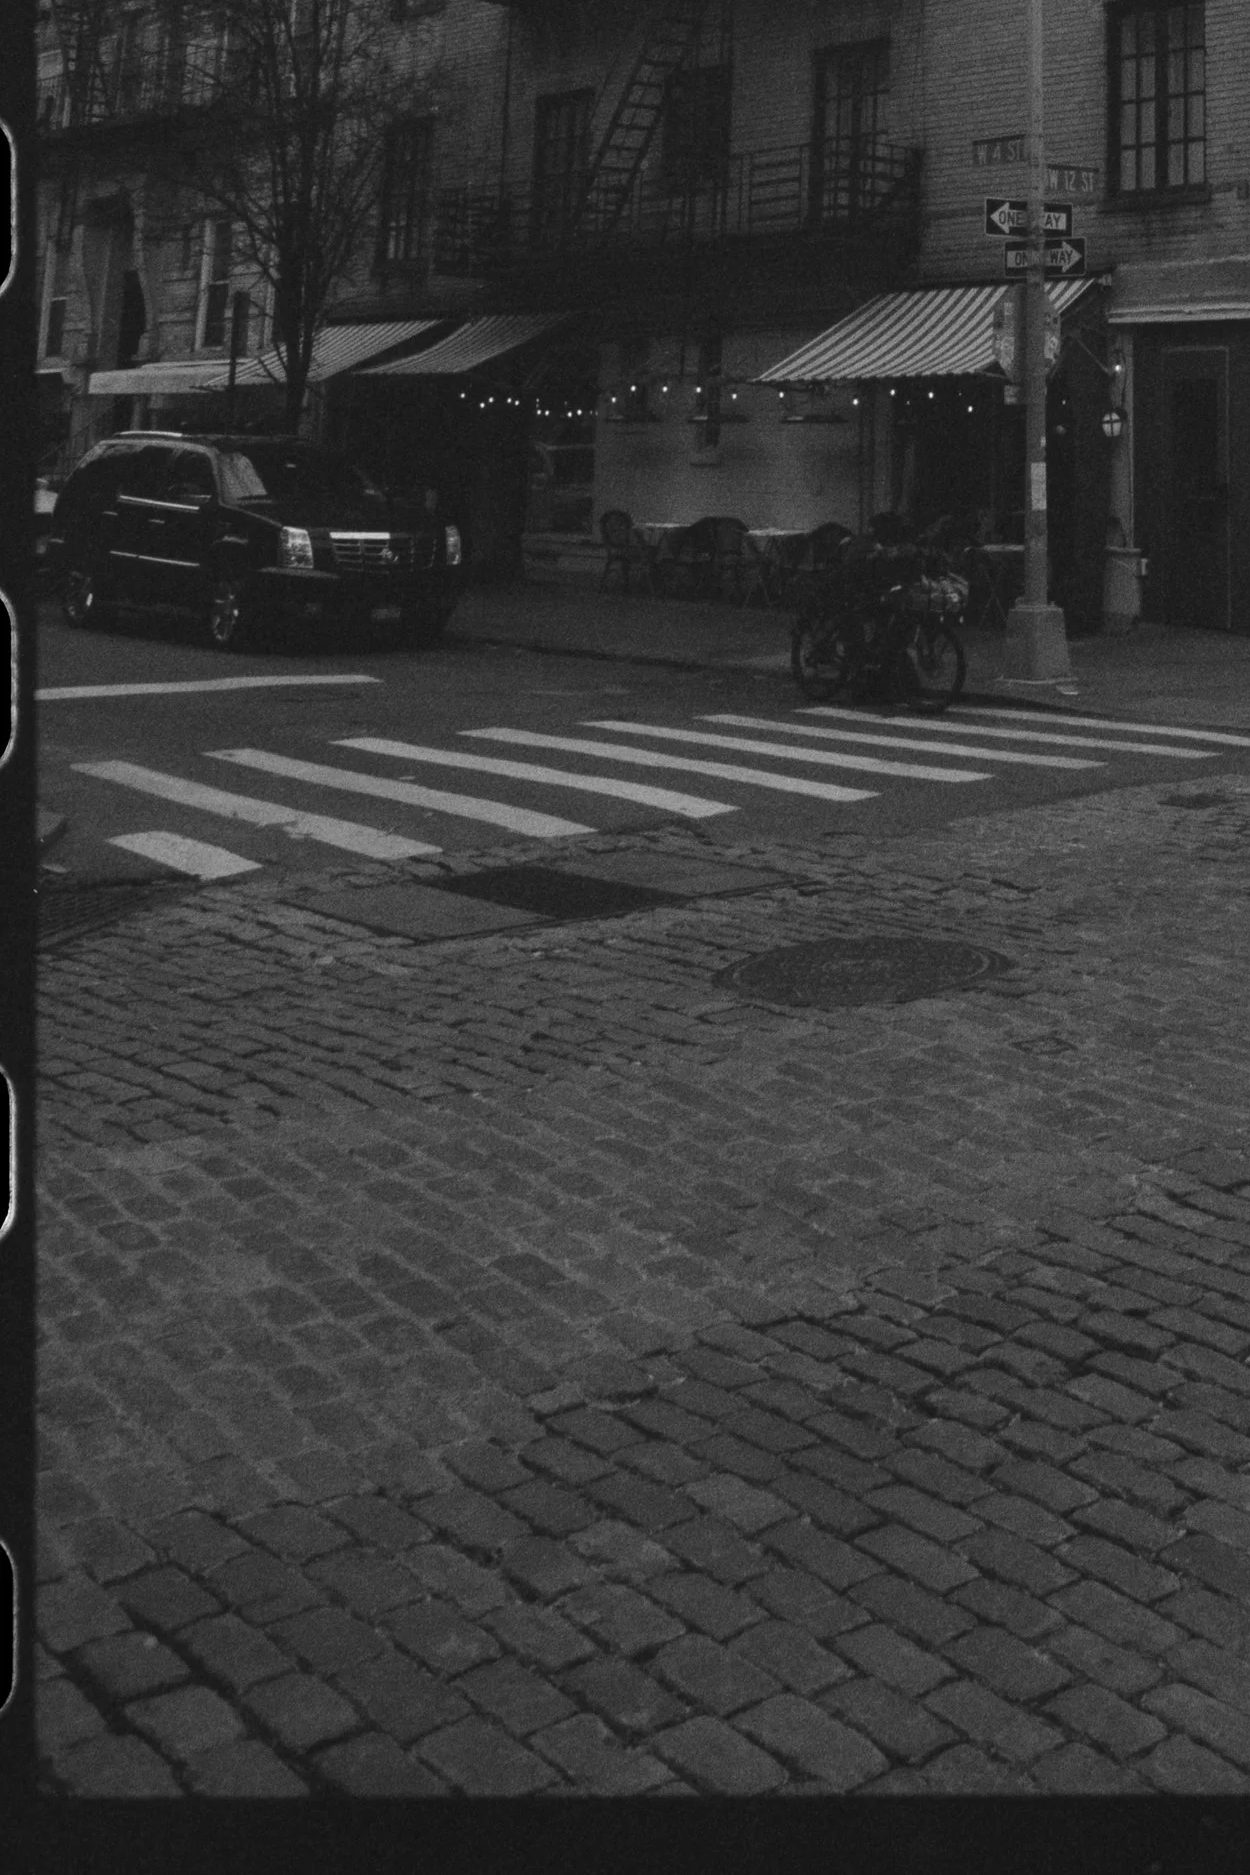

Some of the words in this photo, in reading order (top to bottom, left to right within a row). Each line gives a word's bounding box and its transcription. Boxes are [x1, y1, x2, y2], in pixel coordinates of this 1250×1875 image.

[977, 144, 987, 165] W
[992, 142, 1001, 161] 4
[1007, 139, 1022, 161] ST
[1048, 170, 1058, 190] W
[1064, 170, 1076, 191] 12
[1081, 171, 1094, 192] ST
[999, 211, 1024, 226] ONE
[1043, 213, 1061, 227] AY
[1014, 252, 1028, 266] ON
[1049, 249, 1073, 265] WAY
